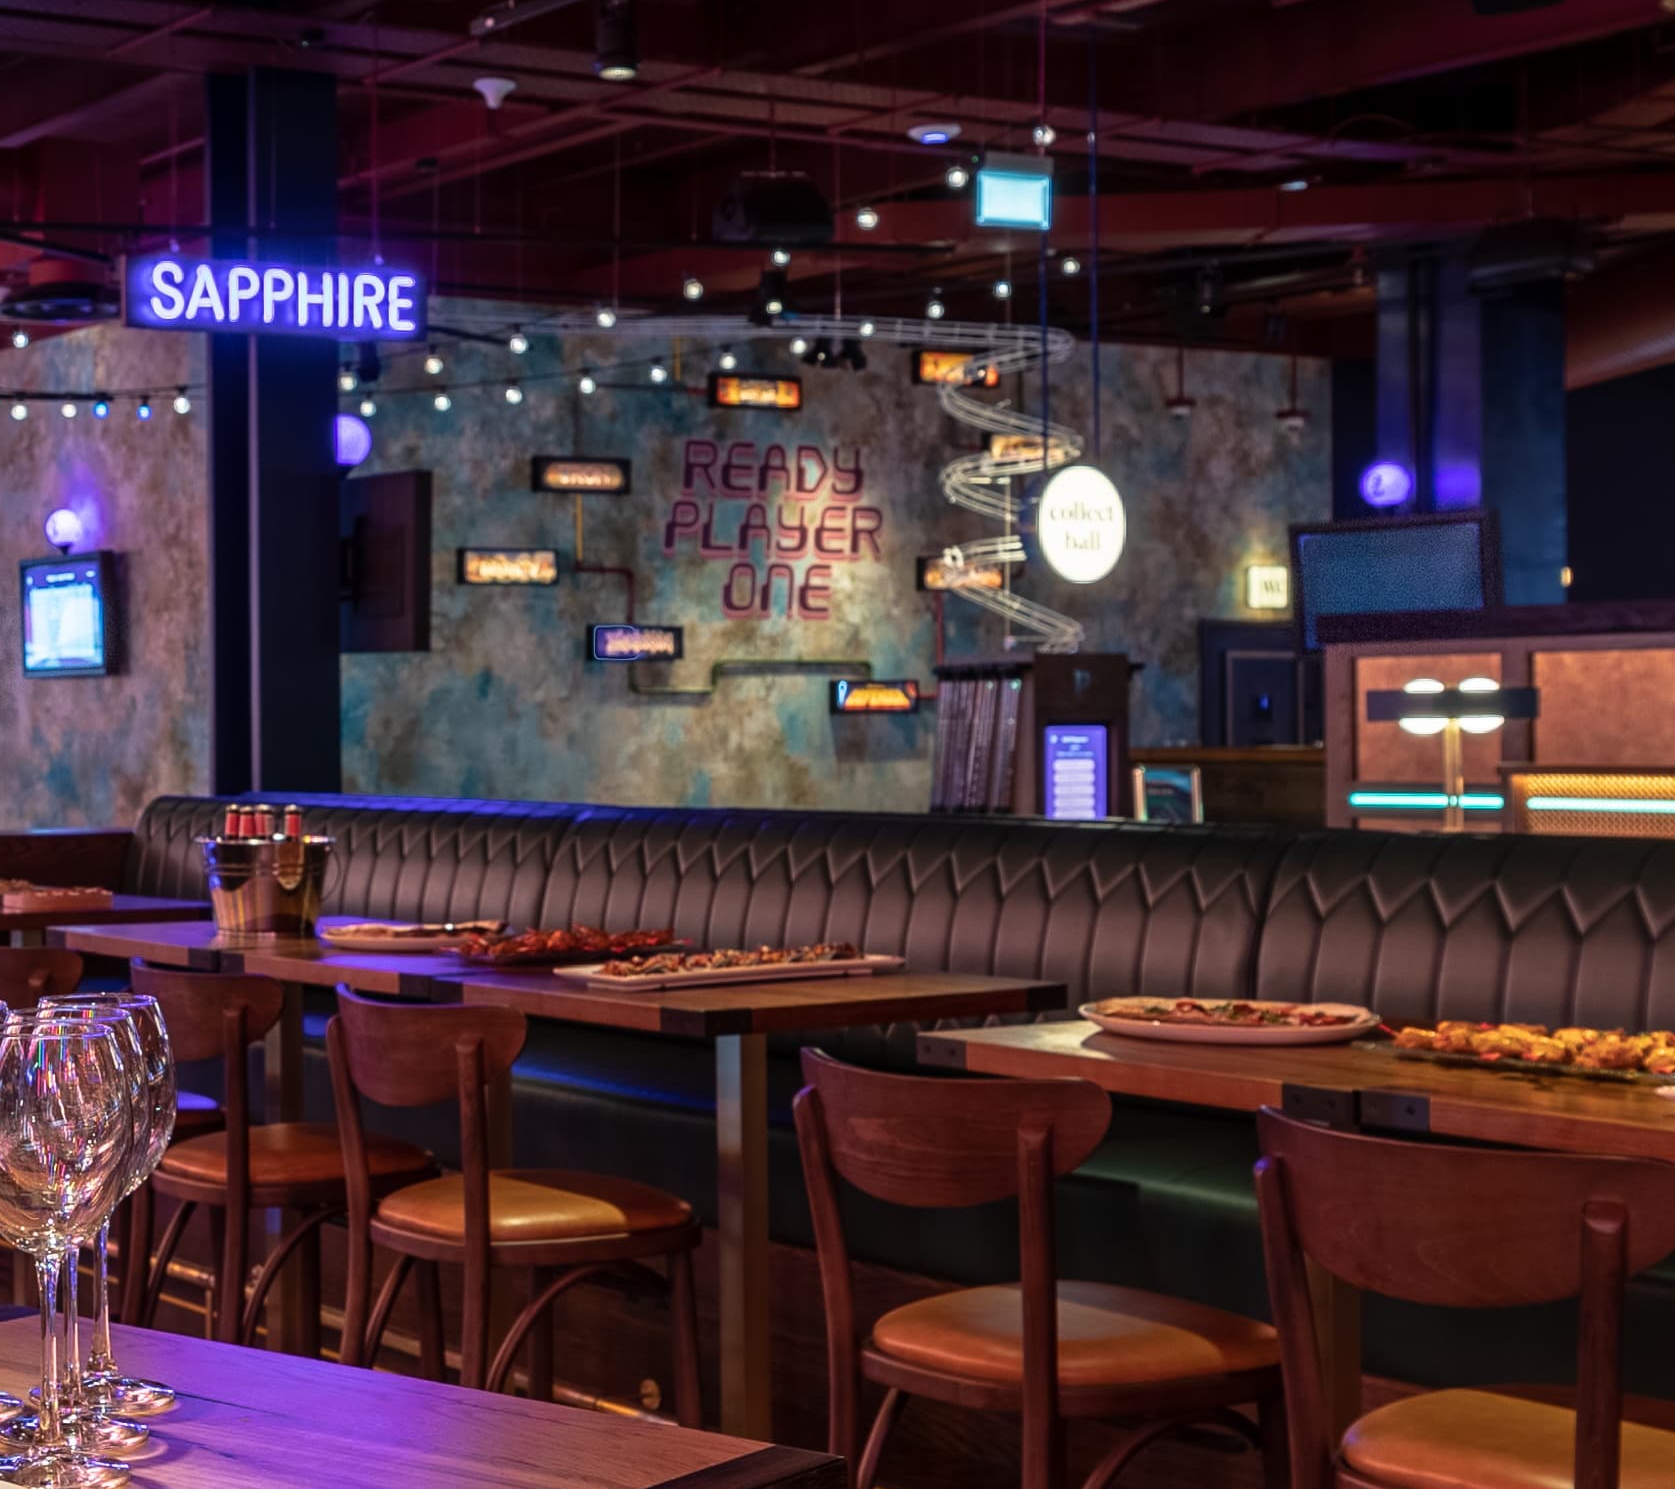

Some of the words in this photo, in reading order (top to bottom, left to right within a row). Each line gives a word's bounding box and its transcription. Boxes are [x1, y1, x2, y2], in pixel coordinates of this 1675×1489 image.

[150, 260, 416, 331] SAPPHIRE
[682, 439, 865, 499] READY
[663, 501, 883, 561] PLAYER
[1050, 501, 1114, 521] collect
[1064, 530, 1101, 551] ball
[721, 563, 833, 620] ONE
